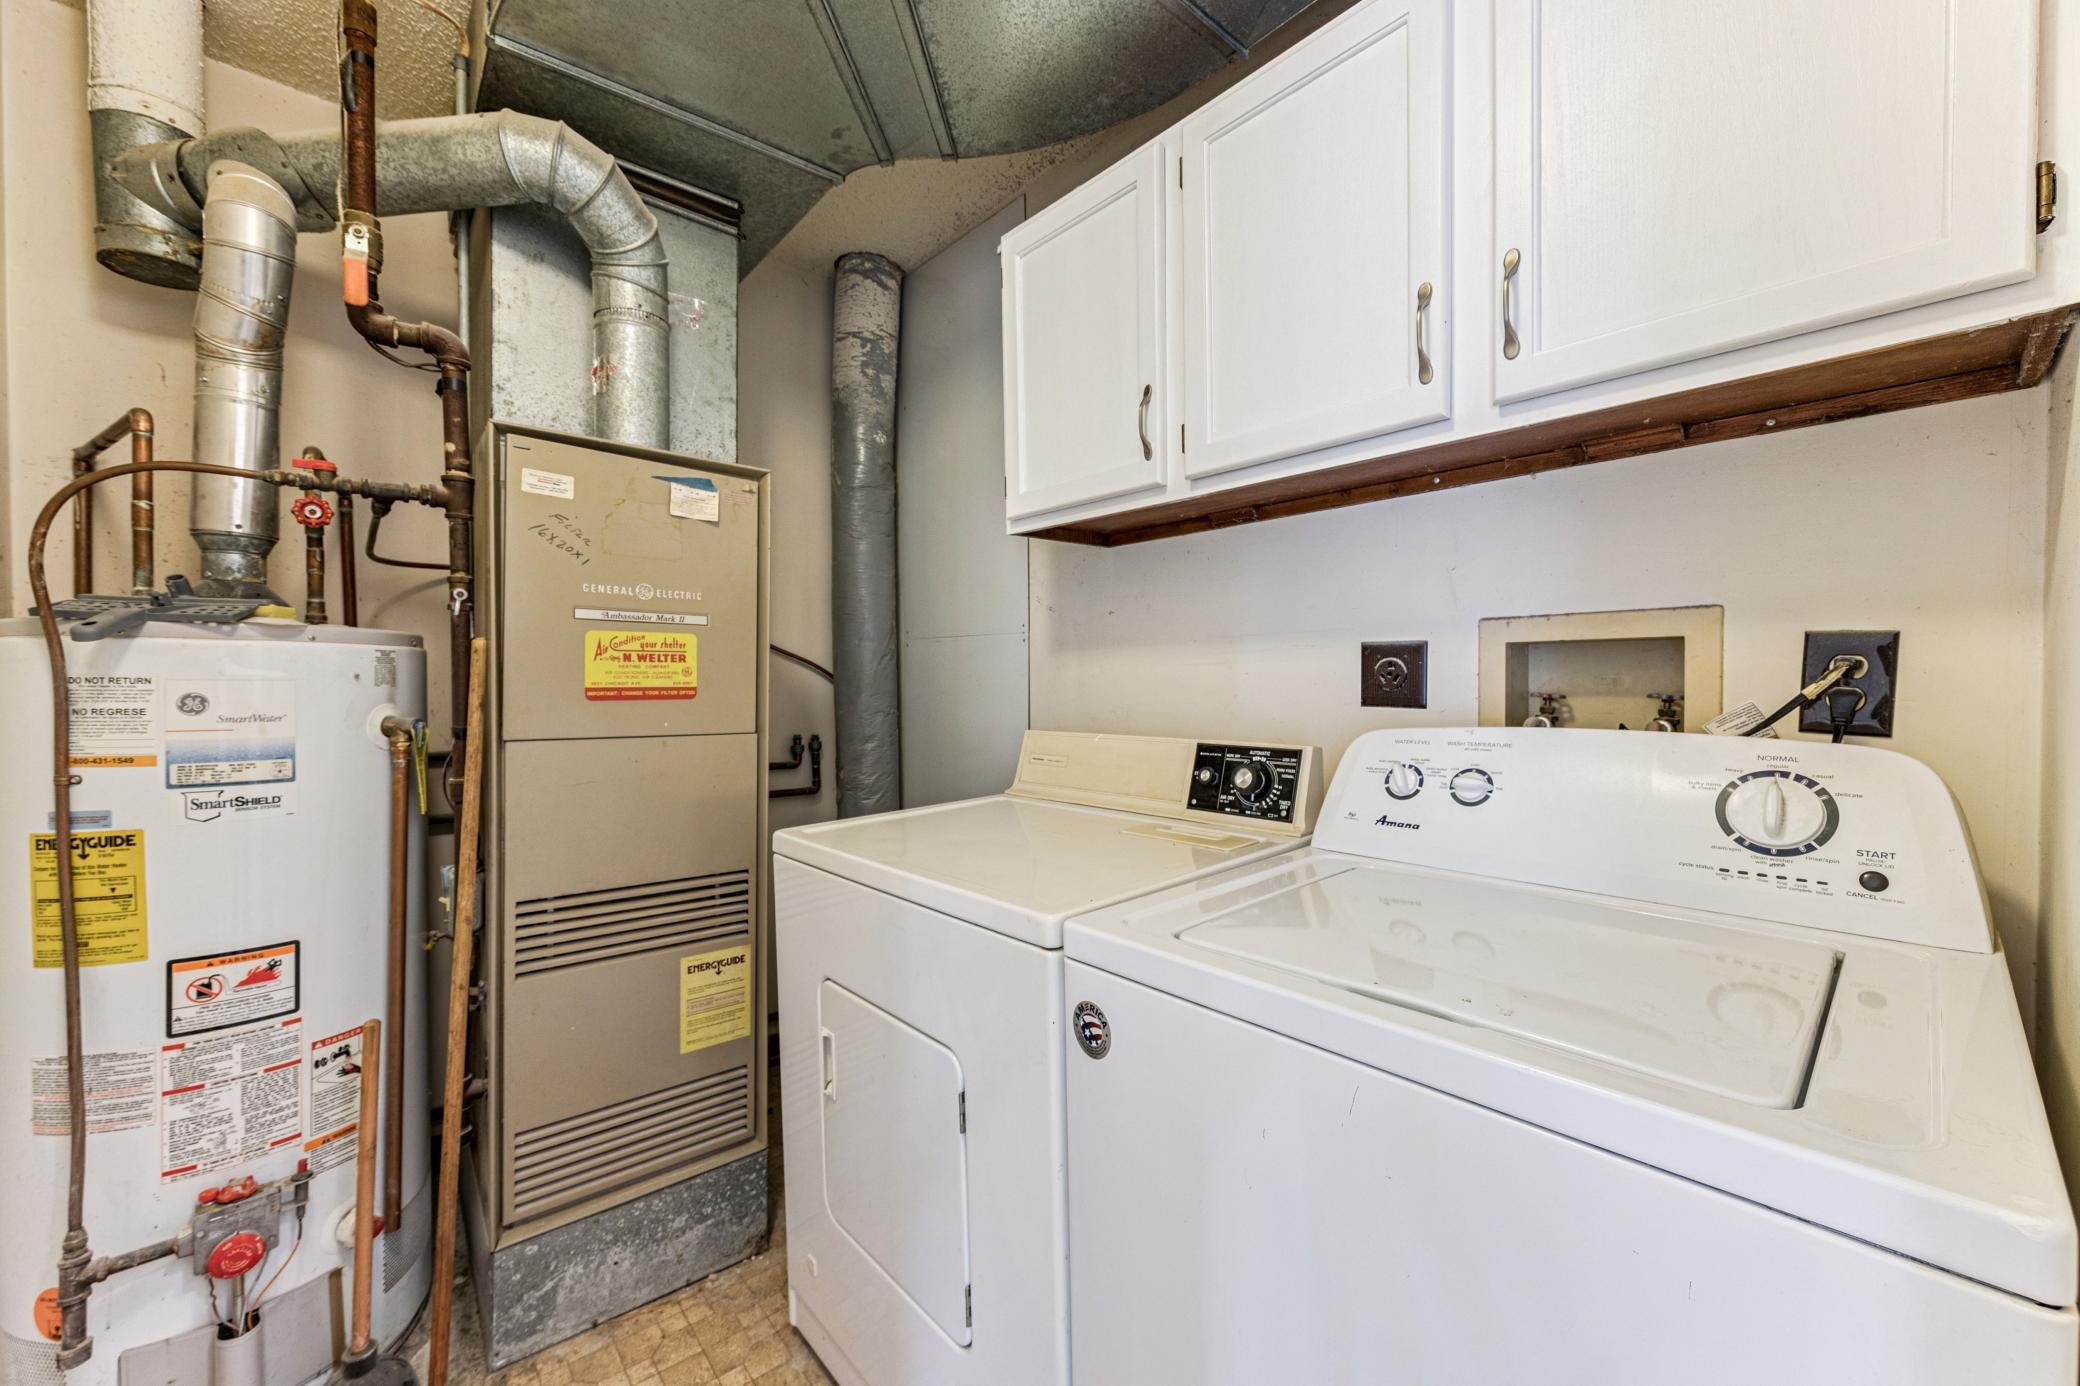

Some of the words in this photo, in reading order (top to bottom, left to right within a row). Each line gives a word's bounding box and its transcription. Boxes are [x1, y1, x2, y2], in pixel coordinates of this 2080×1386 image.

[582, 582, 634, 596] GENERAL
[656, 589, 703, 601] ELECTRIC
[602, 611, 652, 621] Ambassador
[655, 614, 676, 623] Mark
[594, 637, 609, 661] Air
[609, 635, 646, 651] Condition
[639, 641, 658, 651] your
[660, 637, 687, 649] shelter
[637, 653, 687, 663] WELTER
[67, 676, 83, 685] DO
[84, 676, 105, 685] NOT
[108, 677, 152, 685] RETURN
[71, 708, 88, 716] NO
[91, 708, 147, 716] REGRESE
[216, 713, 285, 724] SmartWater
[1757, 754, 1800, 763] NORMAL
[1374, 814, 1421, 831] Amana
[35, 834, 137, 852] ENEGYGUIDE
[1805, 856, 1841, 865] rinse/spin
[1856, 849, 1897, 861] START
[1846, 891, 1878, 901] CANCEL
[218, 953, 265, 965] WARNING
[687, 954, 746, 976] ENERGYGUIDE
[1074, 1002, 1108, 1030] AMERICA
